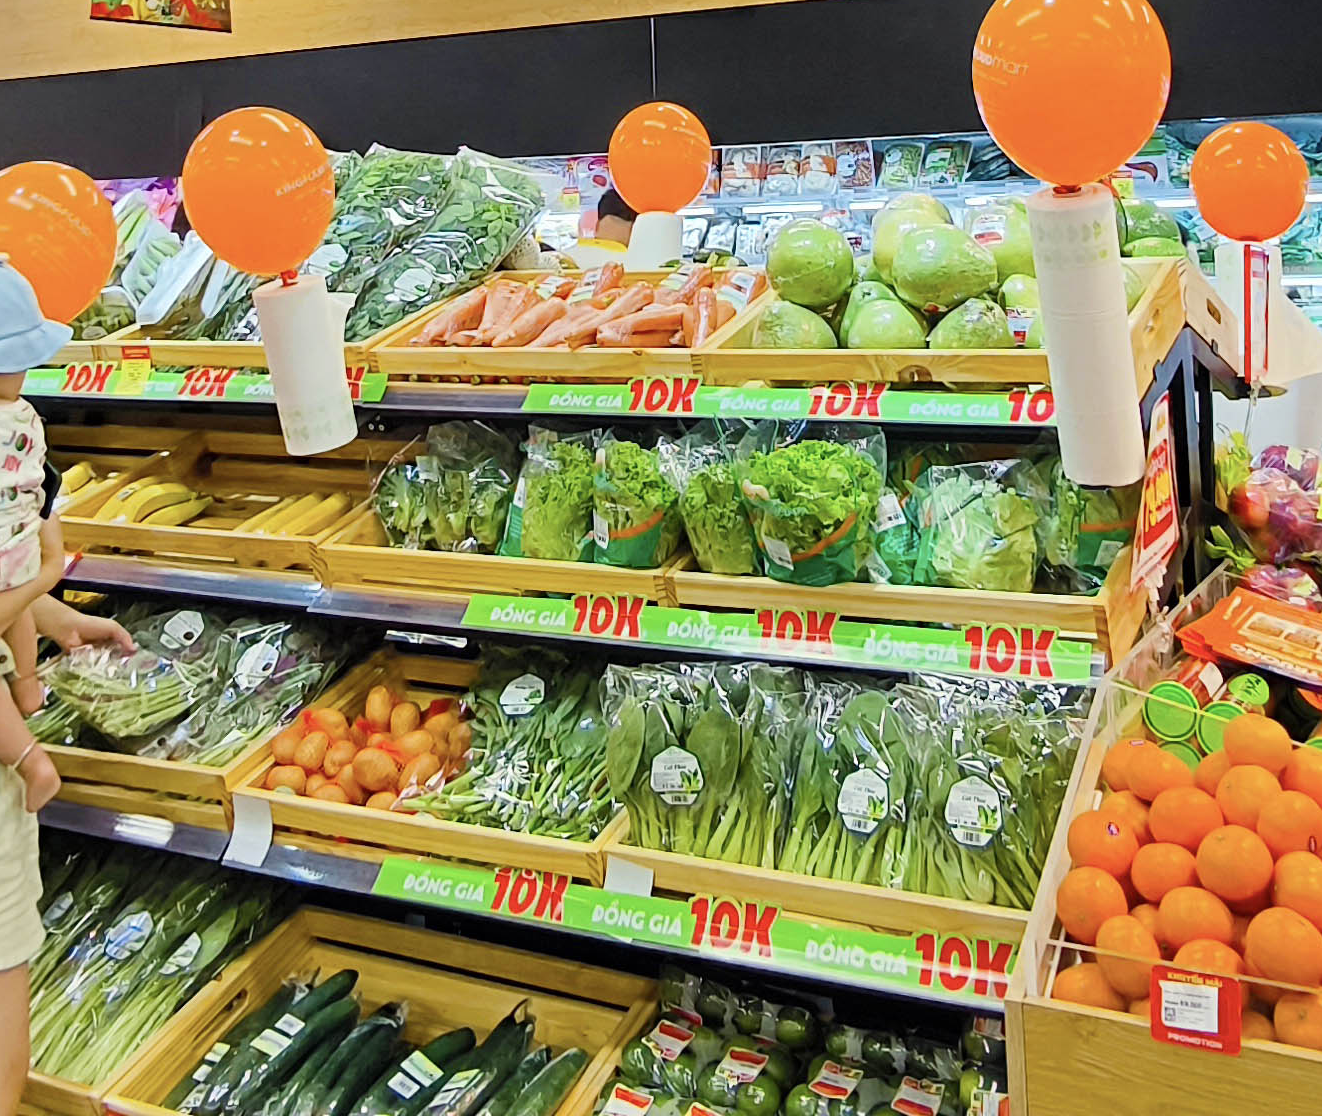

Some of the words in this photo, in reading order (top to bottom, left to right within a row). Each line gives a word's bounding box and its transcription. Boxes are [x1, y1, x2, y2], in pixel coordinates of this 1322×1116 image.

[61, 361, 115, 394] 10K
[178, 366, 235, 397] 10K
[596, 393, 623, 409] GIÁ
[628, 378, 700, 413] 10K
[808, 381, 887, 417] 10K
[967, 402, 1000, 419] GIÁ
[490, 604, 535, 626] ĐỒNG
[538, 608, 566, 627] GIÁ
[573, 595, 644, 638] 10K
[757, 609, 838, 654] 10K
[965, 626, 1056, 677] 10K
[403, 870, 452, 897] ĐỒNG
[454, 880, 485, 903] GIÁ
[490, 867, 569, 922] 10K
[591, 900, 645, 928] ĐỒNG
[649, 912, 683, 937] GIÁ
[690, 897, 778, 958] 10K
[914, 933, 1014, 999] 10K
